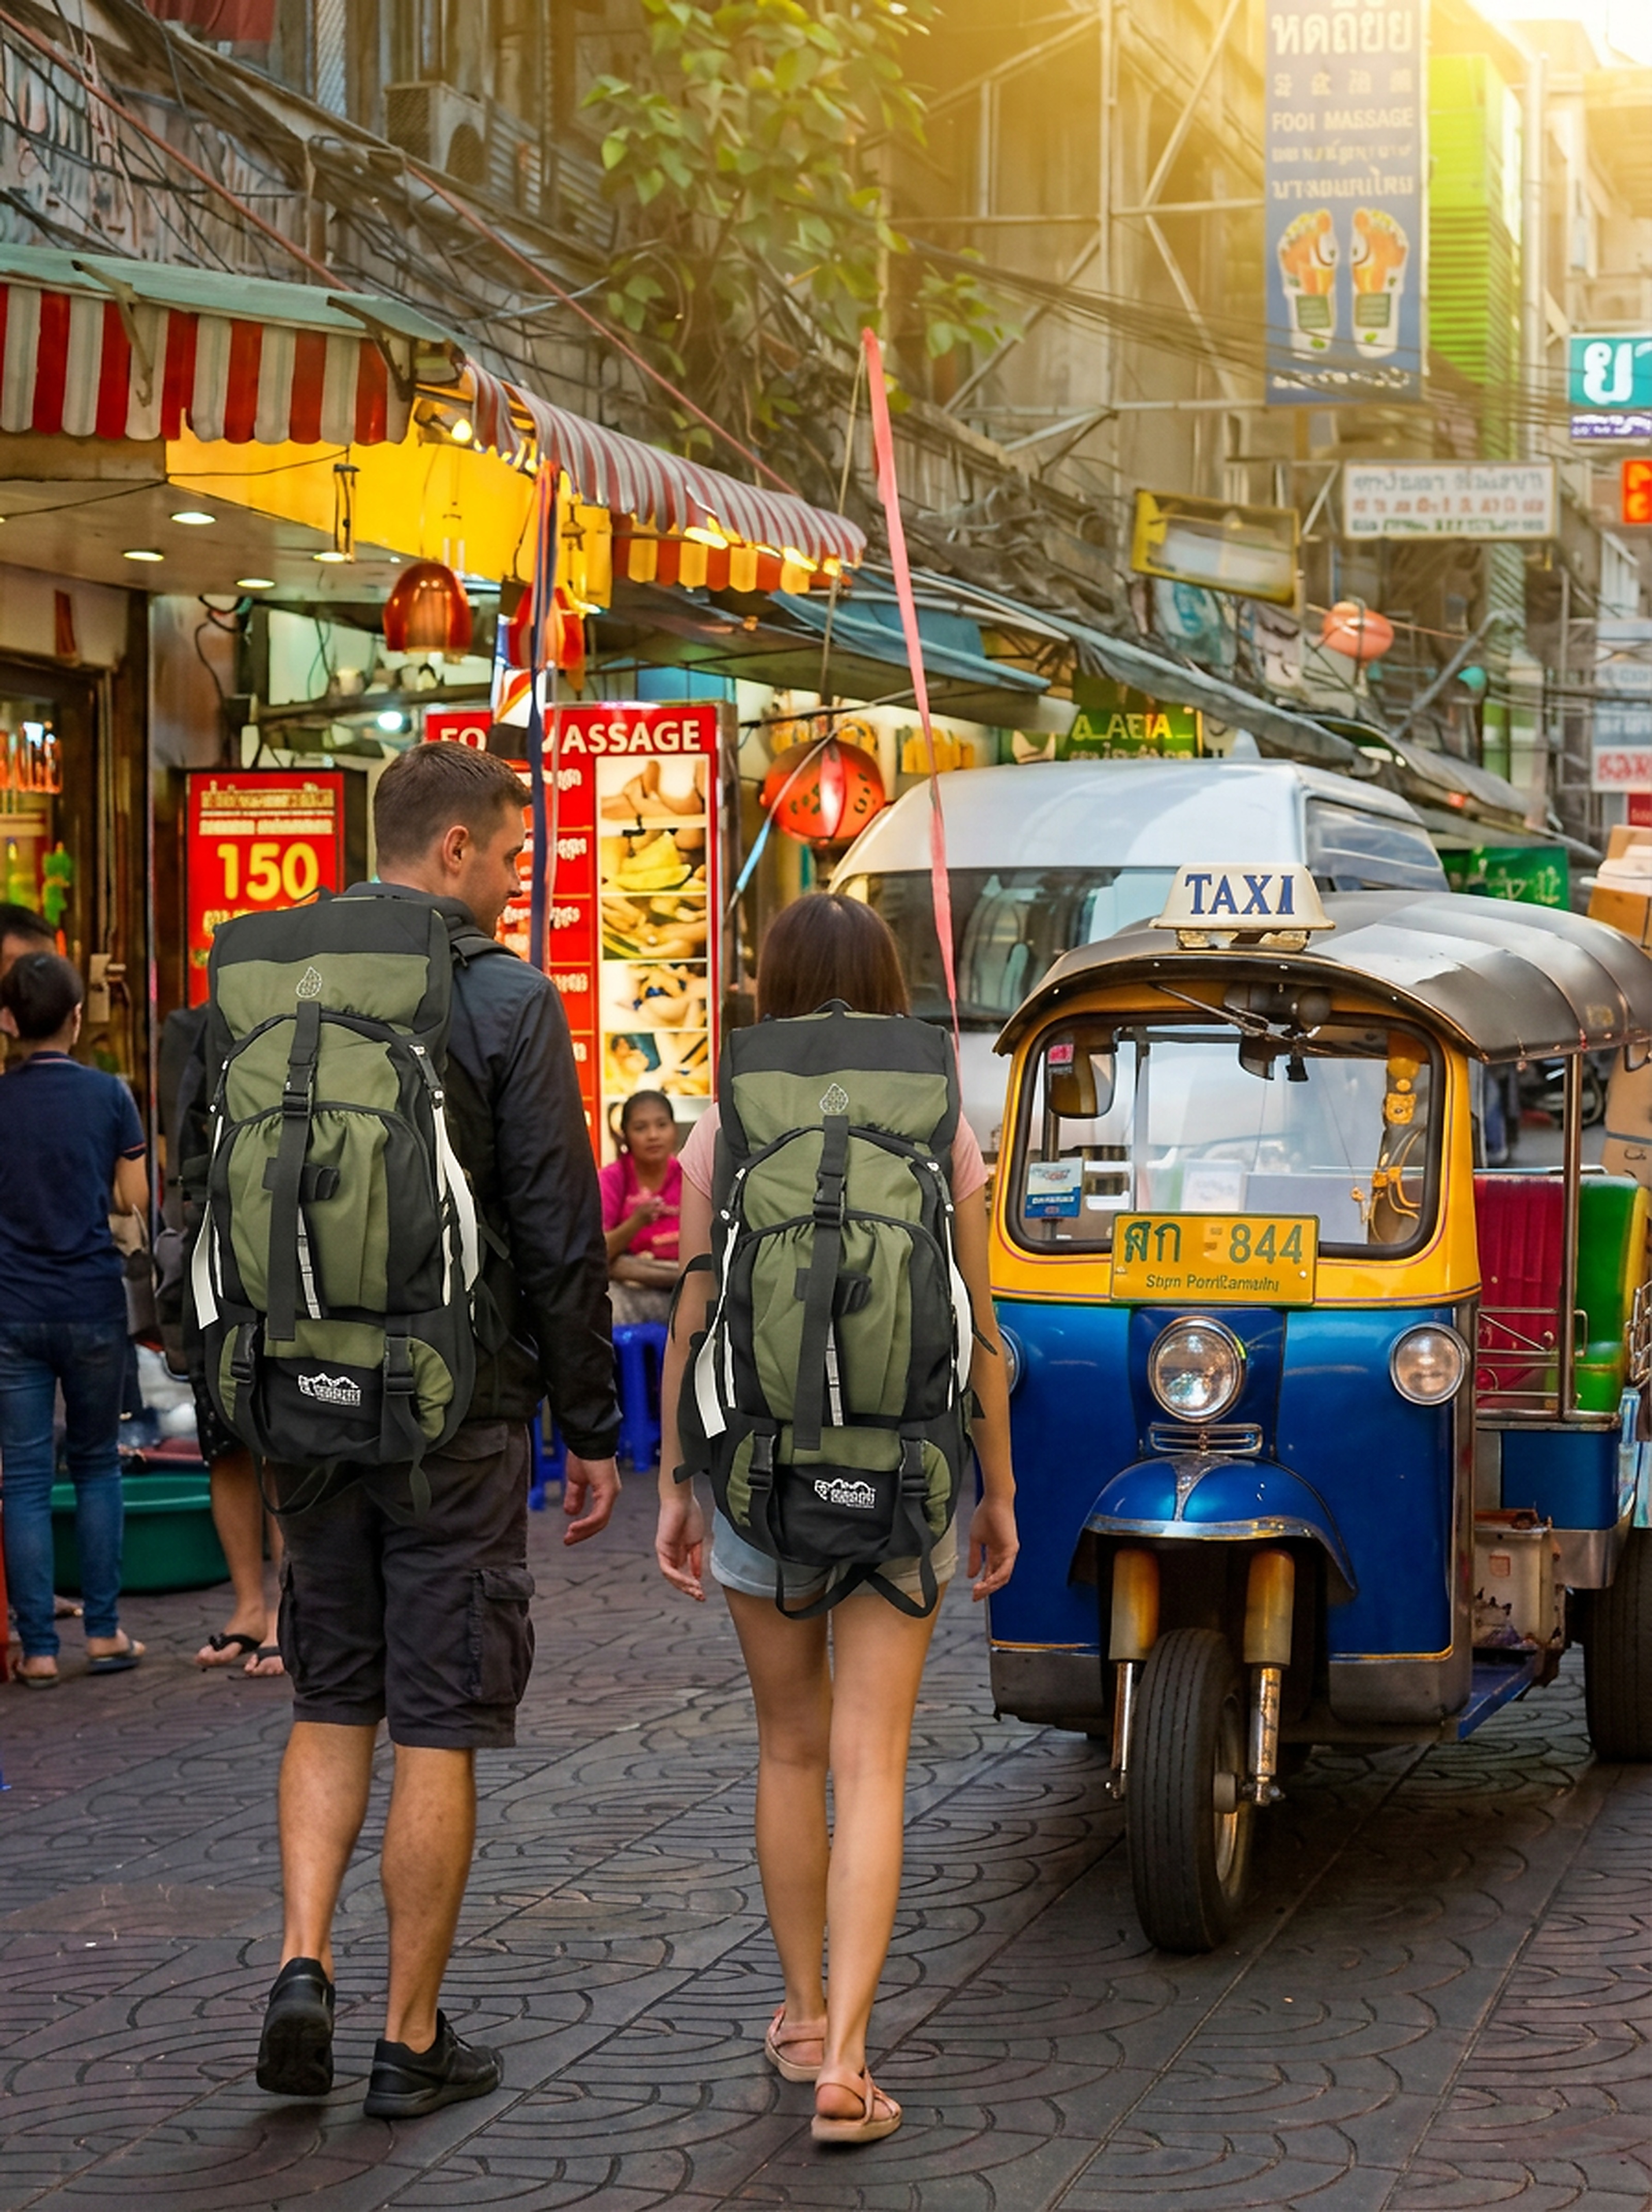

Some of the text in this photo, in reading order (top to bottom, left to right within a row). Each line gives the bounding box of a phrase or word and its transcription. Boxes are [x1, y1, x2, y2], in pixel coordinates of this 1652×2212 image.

[1323, 106, 1414, 131] MASSAGE
[217, 842, 319, 901] 150
[1184, 874, 1295, 915] TAXI
[1229, 1223, 1302, 1265] 844
